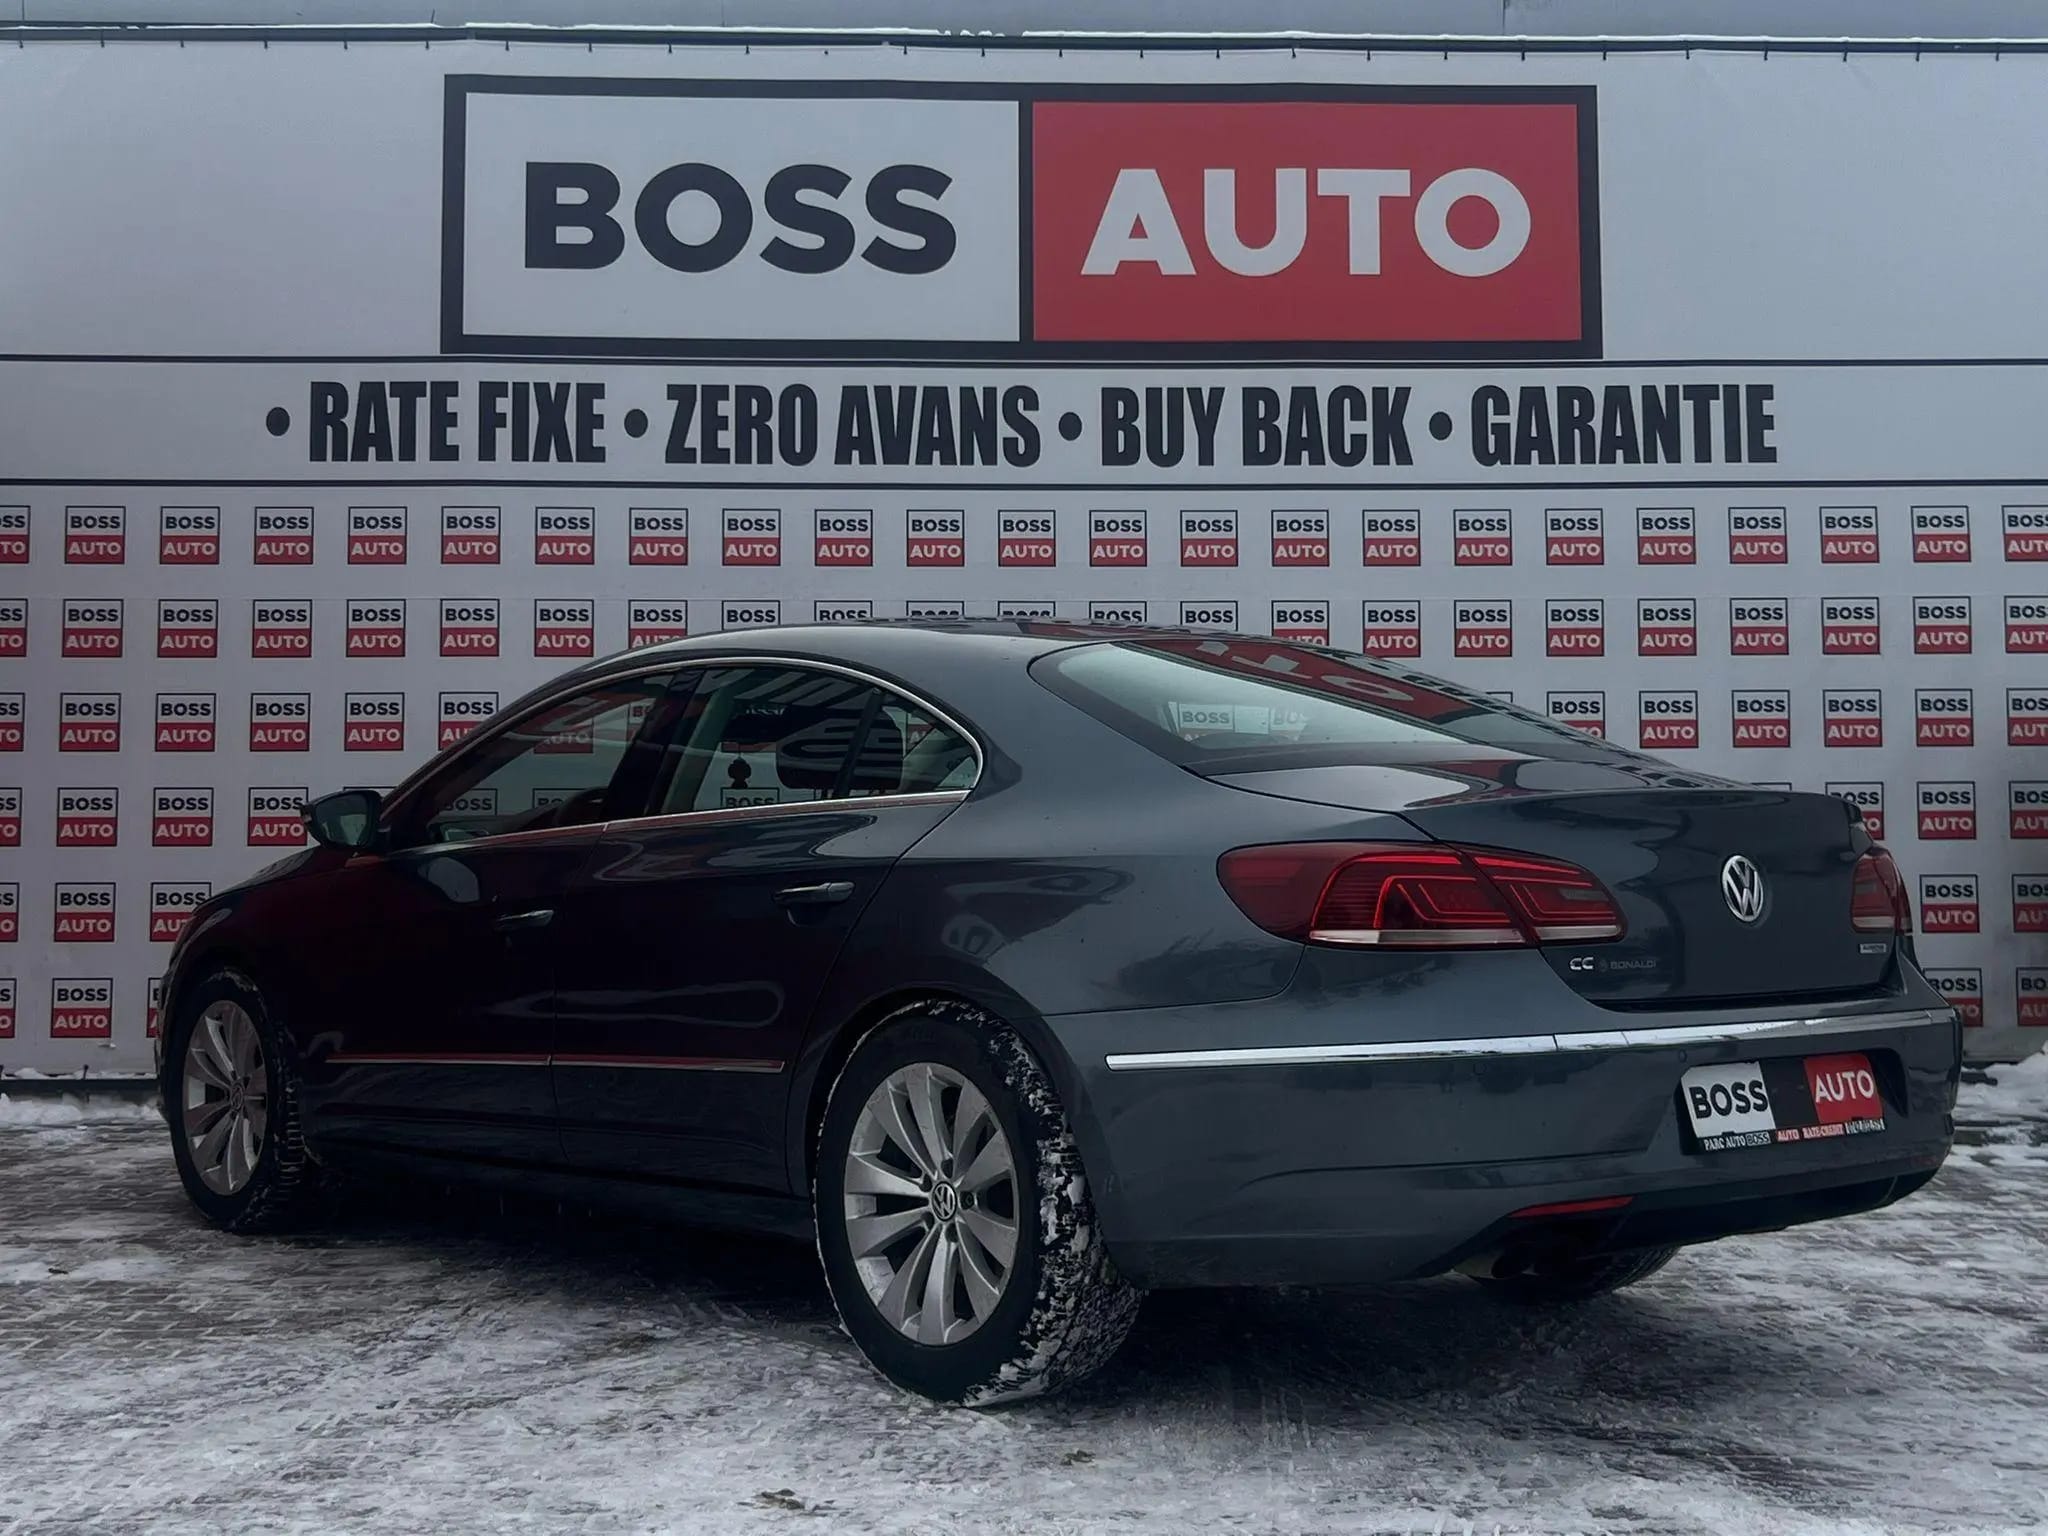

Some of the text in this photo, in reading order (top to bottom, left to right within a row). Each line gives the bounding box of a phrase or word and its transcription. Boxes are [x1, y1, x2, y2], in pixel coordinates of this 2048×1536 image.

[525, 162, 1532, 277] BOSS AUTO
[310, 381, 1777, 467] RATE FIXE ZERO AVANS BUY BACK GARANTIE
[0, 515, 25, 529] SS
[70, 516, 120, 529] BOSS
[165, 516, 215, 530] BOSS
[259, 517, 309, 530] BOSS
[353, 516, 402, 530] BOSS
[446, 516, 496, 530] BOSS
[540, 517, 590, 530] BOSS
[634, 518, 683, 531] BOSS
[727, 519, 776, 532] BOSS
[819, 519, 868, 532] BOSS
[911, 519, 960, 533] BOSS
[1002, 520, 1051, 533] BOSS
[1094, 520, 1142, 533] BOSS
[1184, 520, 1233, 533] BOSS
[1276, 520, 1324, 533] BOSS
[1367, 519, 1415, 532] BOSS
[1458, 519, 1506, 532] BOSS
[1549, 518, 1598, 531] BOSS
[1641, 517, 1690, 531] BOSS
[1733, 517, 1781, 530] BOSS
[1824, 516, 1873, 529] BOSS
[1916, 515, 1965, 529] BOSS
[2007, 515, 2048, 528] BOS
[0, 541, 26, 555] TO
[68, 541, 122, 556] AUTO
[164, 542, 216, 556] AUTO
[258, 542, 310, 556] AUTO
[351, 542, 403, 556] AUTO
[445, 541, 497, 555] AUTO
[539, 542, 591, 556] AUTO
[633, 543, 685, 557] AUTO
[726, 543, 778, 557] AUTO
[818, 544, 870, 558] AUTO
[910, 544, 962, 558] AUTO
[1001, 544, 1053, 558] AUTO
[1094, 544, 1144, 558] AUTO
[1184, 544, 1235, 558] AUTO
[1275, 544, 1327, 558] AUTO
[1367, 544, 1418, 558] AUTO
[1457, 543, 1509, 558] AUTO
[1550, 543, 1601, 557] AUTO
[1641, 542, 1693, 556] AUTO
[1733, 541, 1784, 556] AUTO
[1825, 540, 1877, 555] AUTO
[1917, 540, 1967, 554] AUTO
[2008, 539, 2048, 553] AUT
[0, 608, 22, 622] SS
[67, 609, 118, 622] BOSS
[163, 609, 213, 623] BOSS
[257, 609, 307, 623] BOSS
[351, 609, 401, 622] BOSS
[445, 608, 495, 622] BOSS
[539, 609, 589, 622] BOSS
[633, 609, 683, 622] BOSS
[727, 609, 777, 623] BOSS
[1184, 610, 1233, 623] BOSS
[1276, 610, 1325, 623] BOSS
[1367, 610, 1416, 623] BOSS
[1459, 610, 1507, 623] BOSS
[1550, 609, 1599, 622] BOSS
[1642, 608, 1691, 622] BOSS
[1734, 608, 1783, 621] BOSS
[1826, 607, 1875, 620] BOSS
[1917, 606, 1966, 620] BOSS
[2009, 606, 2048, 619] BOS
[0, 634, 24, 648] TO
[65, 634, 119, 649] AUTO
[161, 635, 214, 649] AUTO
[255, 635, 309, 649] AUTO
[350, 634, 402, 649] AUTO
[443, 633, 496, 648] AUTO
[537, 634, 591, 649] AUTO
[1366, 635, 1418, 649] AUTO
[1457, 634, 1509, 649] AUTO
[1550, 634, 1601, 648] AUTO
[1642, 633, 1694, 648] AUTO
[1735, 632, 1786, 647] AUTO
[1825, 632, 1877, 646] AUTO
[1917, 631, 1968, 646] AUTO
[2009, 630, 2048, 645] AUT
[64, 703, 116, 717] BOSS
[160, 703, 211, 717] BOSS
[255, 703, 305, 717] BOSS
[349, 703, 399, 716] BOSS
[443, 702, 495, 716] BOSS
[1551, 701, 1600, 714] BOSS
[1643, 701, 1693, 714] BOSS
[1736, 700, 1785, 713] BOSS
[1827, 699, 1877, 713] BOSS
[1920, 699, 1968, 712] BOSS
[2011, 698, 2048, 712] BOS
[1182, 711, 1230, 724] BOSS
[62, 729, 117, 743] AUTO
[158, 729, 212, 743] AUTO
[252, 728, 307, 743] AUTO
[347, 728, 401, 743] AUTO
[1643, 725, 1695, 740] AUTO
[1737, 725, 1787, 739] AUTO
[1828, 724, 1879, 739] AUTO
[1920, 724, 1970, 738] AUTO
[2011, 723, 2048, 738] AUT
[62, 798, 113, 811] BOSS
[157, 798, 208, 811] BOSS
[253, 797, 304, 811] BOSS
[1921, 791, 1971, 805] BOSS
[2013, 791, 2048, 804] BOS
[250, 823, 305, 837] AUTO
[1921, 816, 1973, 831] AUTO
[2013, 816, 2048, 830] AUT
[59, 823, 114, 838] AUTO
[155, 823, 210, 838] AUTO
[1925, 885, 1973, 898] BOSS
[60, 893, 110, 906] BOSS
[1925, 910, 1976, 925] AUTO
[57, 918, 112, 933] AUTO
[2021, 978, 2048, 991] BO
[56, 988, 107, 1002] BOSS
[54, 1014, 108, 1029] AUTO
[1689, 1070, 1874, 1119] BOSS AUTO
[1725, 1136, 1746, 1149] AUTO
